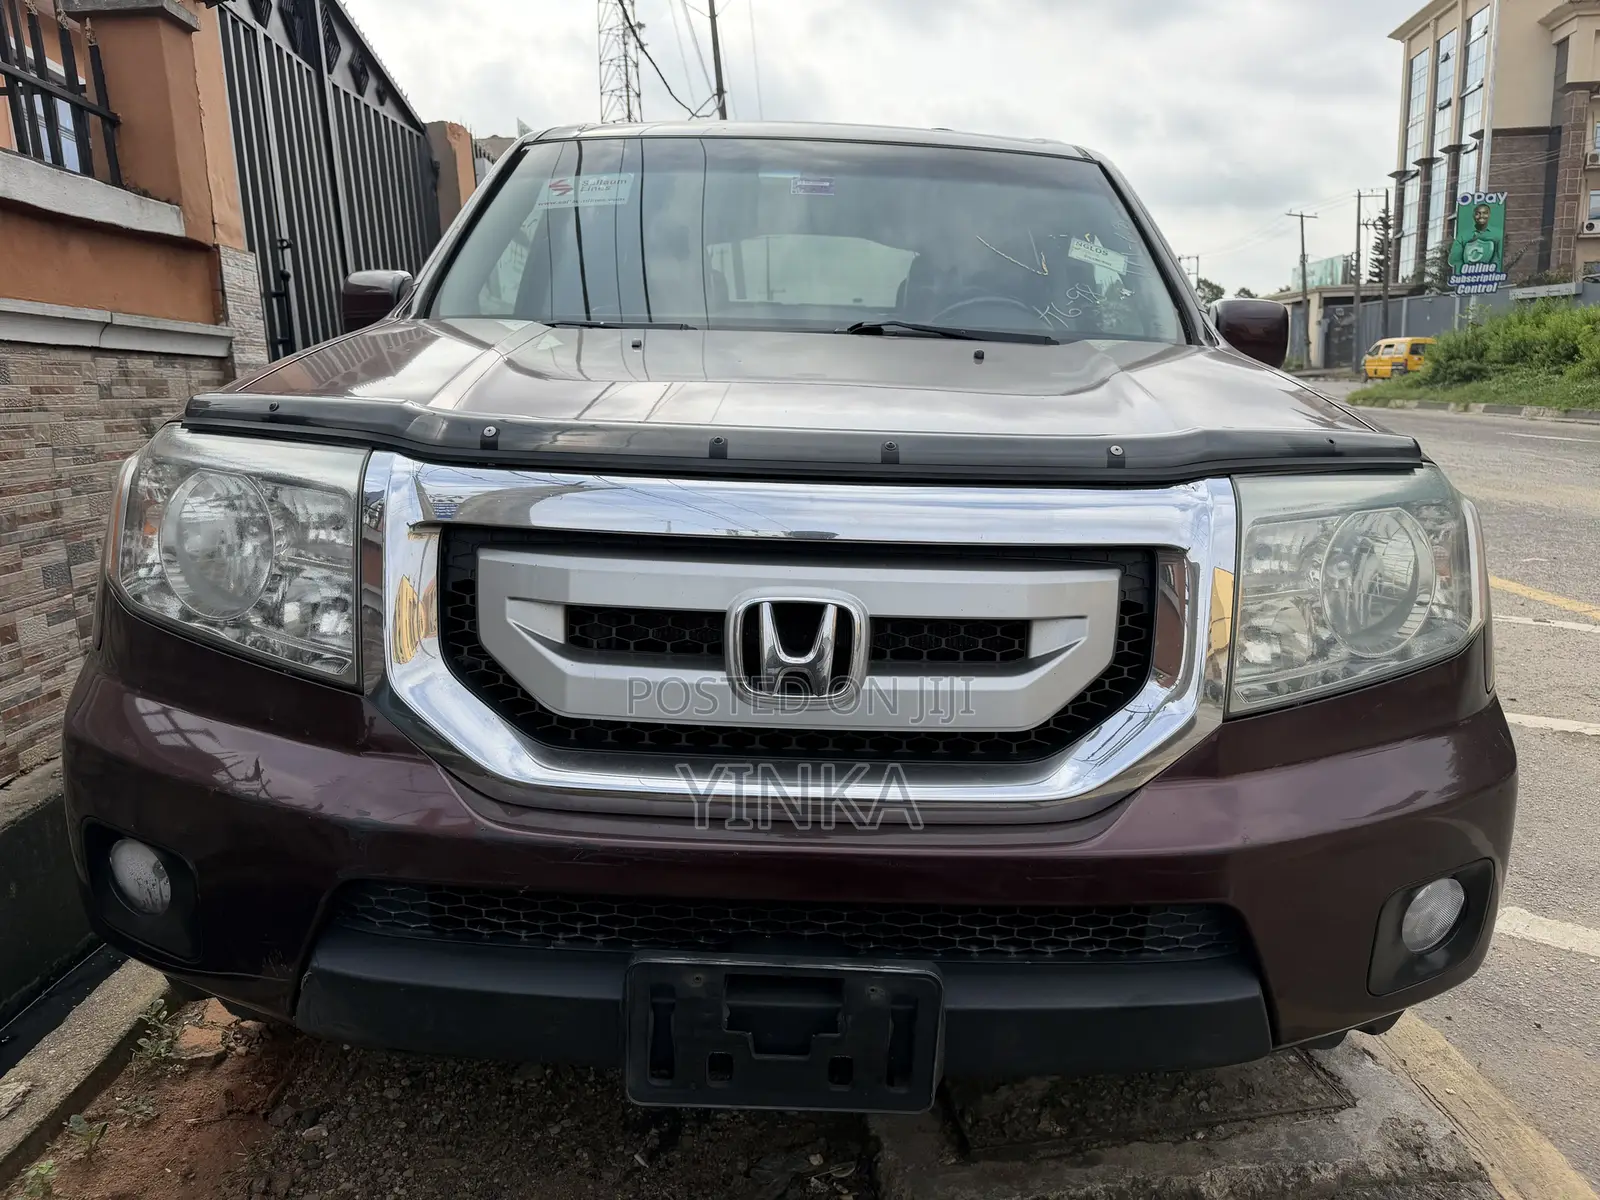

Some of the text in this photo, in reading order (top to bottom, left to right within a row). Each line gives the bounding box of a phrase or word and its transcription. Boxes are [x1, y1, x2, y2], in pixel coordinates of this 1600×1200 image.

[1461, 263, 1496, 273] Online
[1450, 273, 1507, 284] Subscription
[1457, 283, 1498, 294] Control
